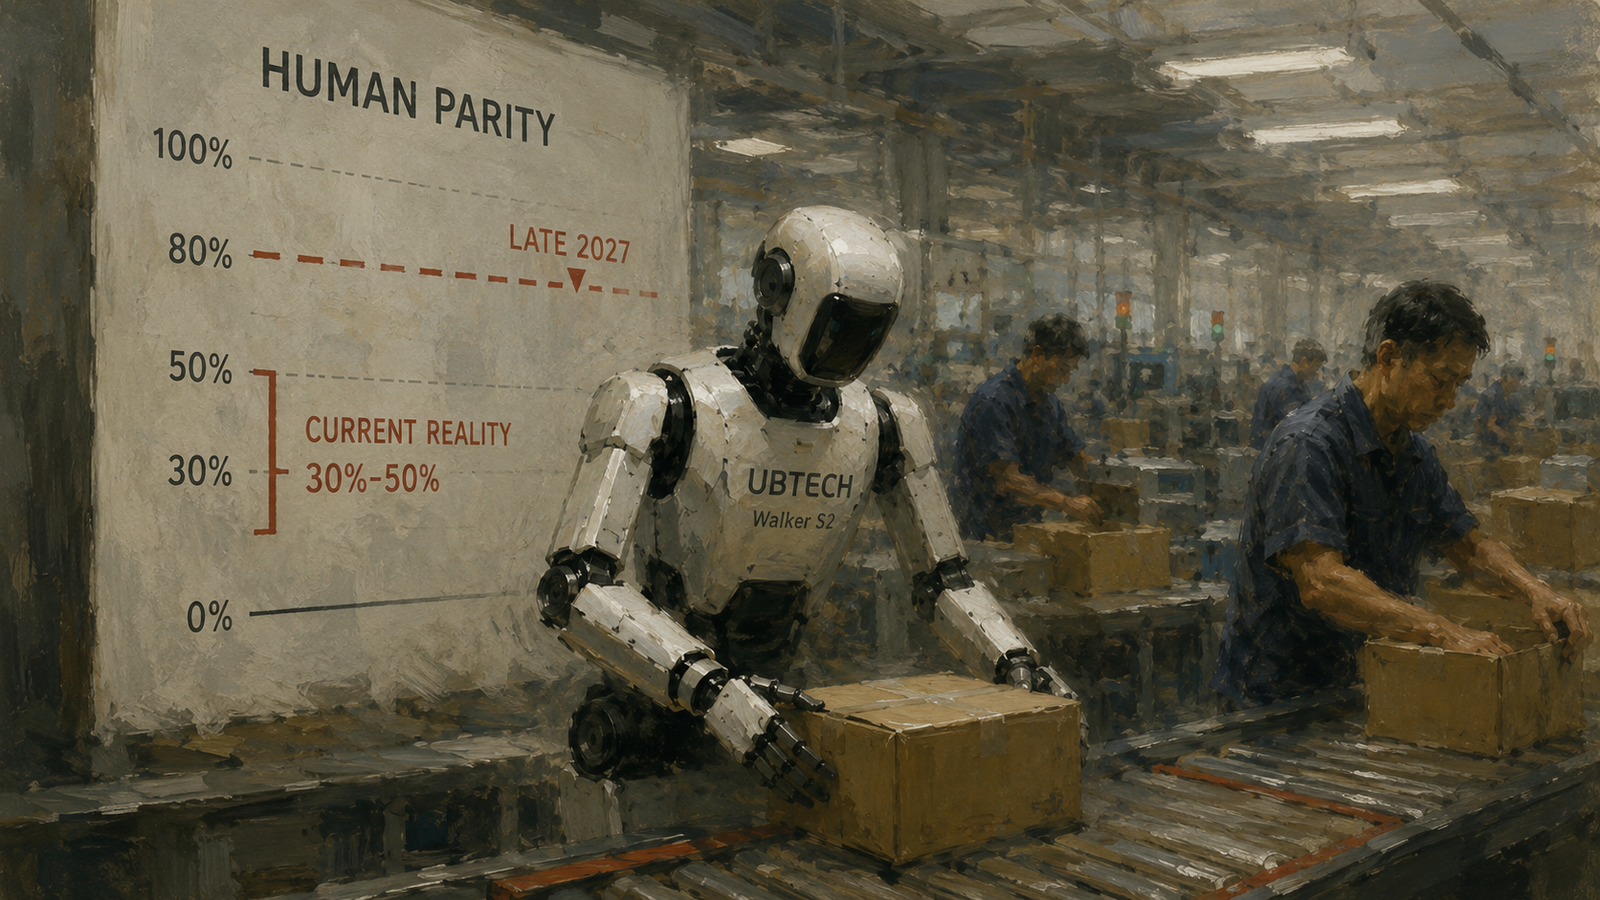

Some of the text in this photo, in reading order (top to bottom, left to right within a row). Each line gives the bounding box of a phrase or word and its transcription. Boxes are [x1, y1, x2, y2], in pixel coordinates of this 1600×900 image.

[261, 46, 556, 147] HUMAN PARITY
[153, 127, 233, 170] 100%
[168, 232, 233, 270] 80%
[509, 223, 631, 265] LATE 2027
[168, 350, 233, 385] 50%
[305, 414, 512, 447] CURRENT REALITY
[167, 454, 233, 487] 30%
[305, 462, 440, 494] 30%-50%
[749, 468, 854, 499] UBTECH
[752, 510, 836, 530] Walker S2
[187, 599, 233, 633] 0%
